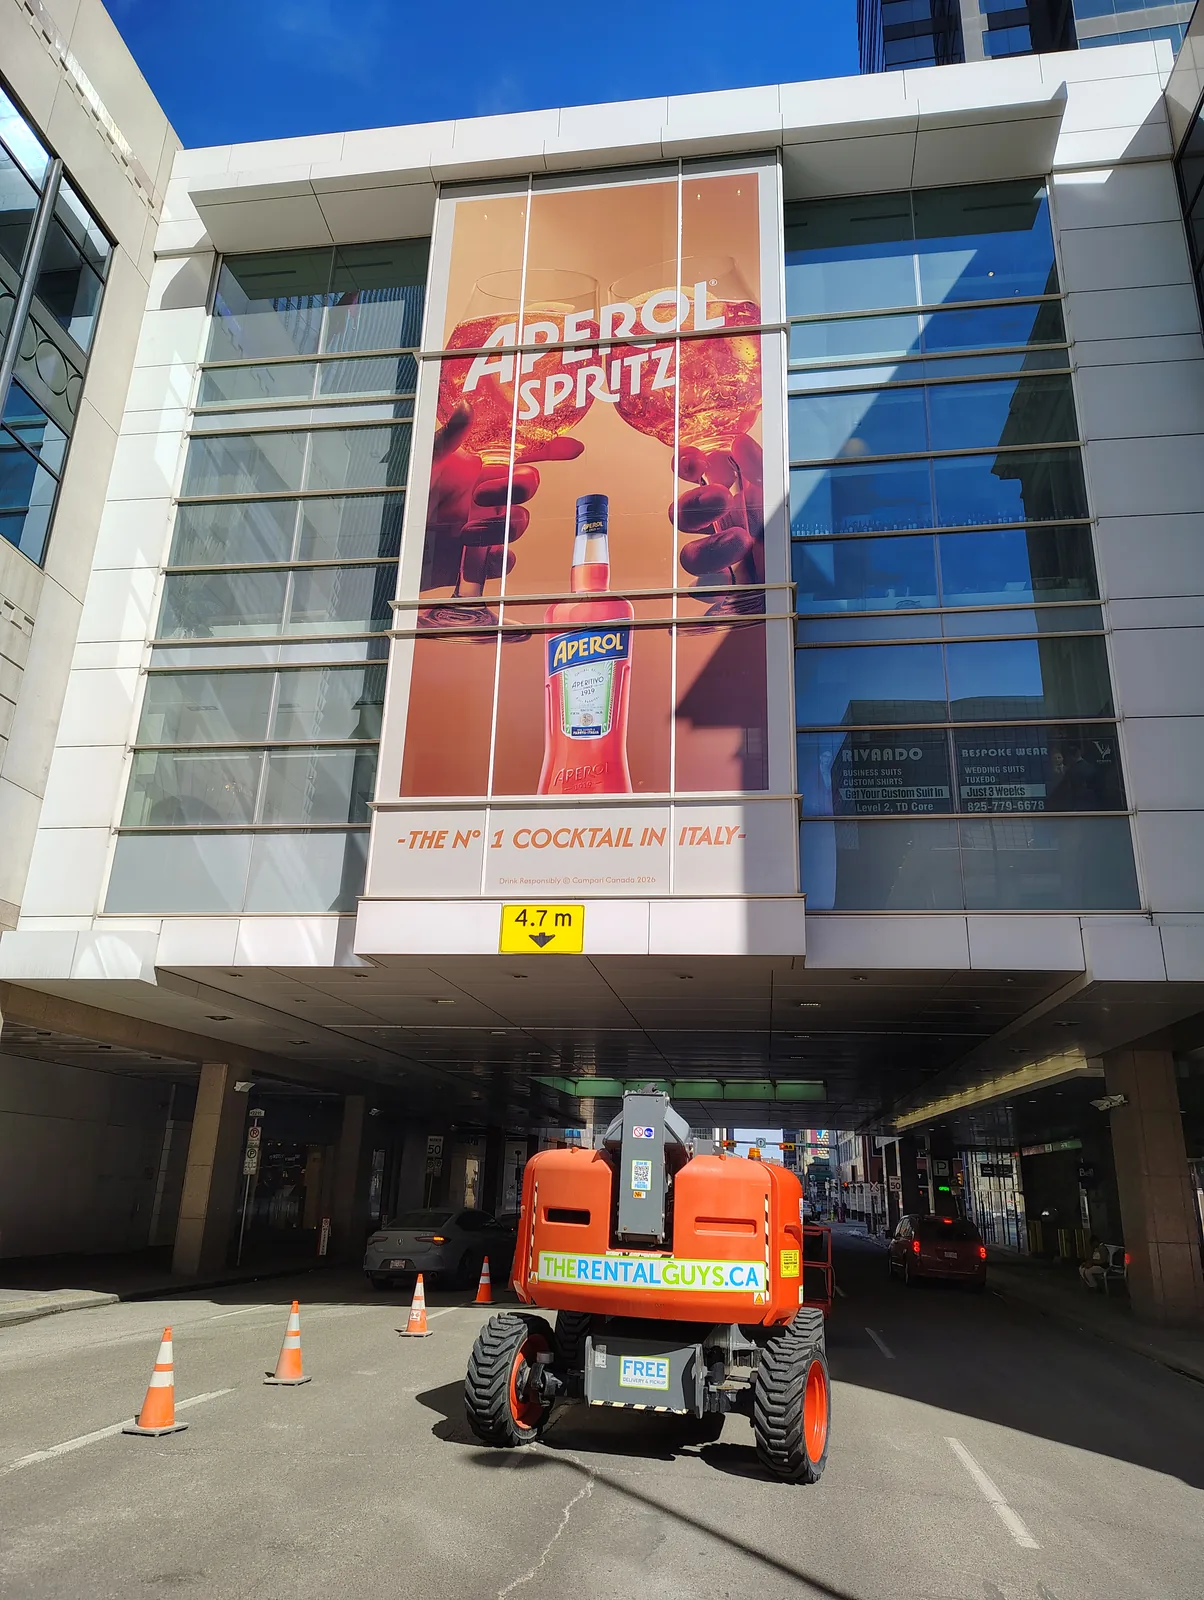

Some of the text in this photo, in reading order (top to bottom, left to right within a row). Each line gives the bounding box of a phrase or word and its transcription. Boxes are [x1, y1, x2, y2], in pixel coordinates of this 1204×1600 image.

[518, 345, 676, 421] SPRITZ
[553, 632, 624, 667] APEROL
[572, 676, 605, 689] APERITIVO
[581, 688, 595, 697] 1919
[961, 747, 1048, 758] BESPOKE WEAR
[843, 768, 902, 777] BUSINESS SUITS
[964, 765, 1025, 774] WEDDING SUITS
[843, 778, 874, 786] CUSTOM
[845, 787, 943, 799] Get Your Custom Suit In
[966, 786, 1026, 798] Just 3 Weeks
[857, 802, 934, 813] Level 2, TD Core
[967, 801, 1045, 812] 825-779-6678
[490, 829, 504, 848] 1
[512, 827, 633, 849] COCKTAIL
[639, 827, 667, 846] IN
[519, 877, 561, 885] Responsibly
[572, 877, 604, 885] Campari
[605, 876, 635, 884] Canada
[514, 909, 572, 927] 4.7 m
[428, 1144, 441, 1155] 50
[936, 1161, 947, 1175] P
[890, 1182, 901, 1190] 50
[543, 1256, 759, 1287] THERENTALGUYS.CA
[623, 1360, 667, 1378] FREE
